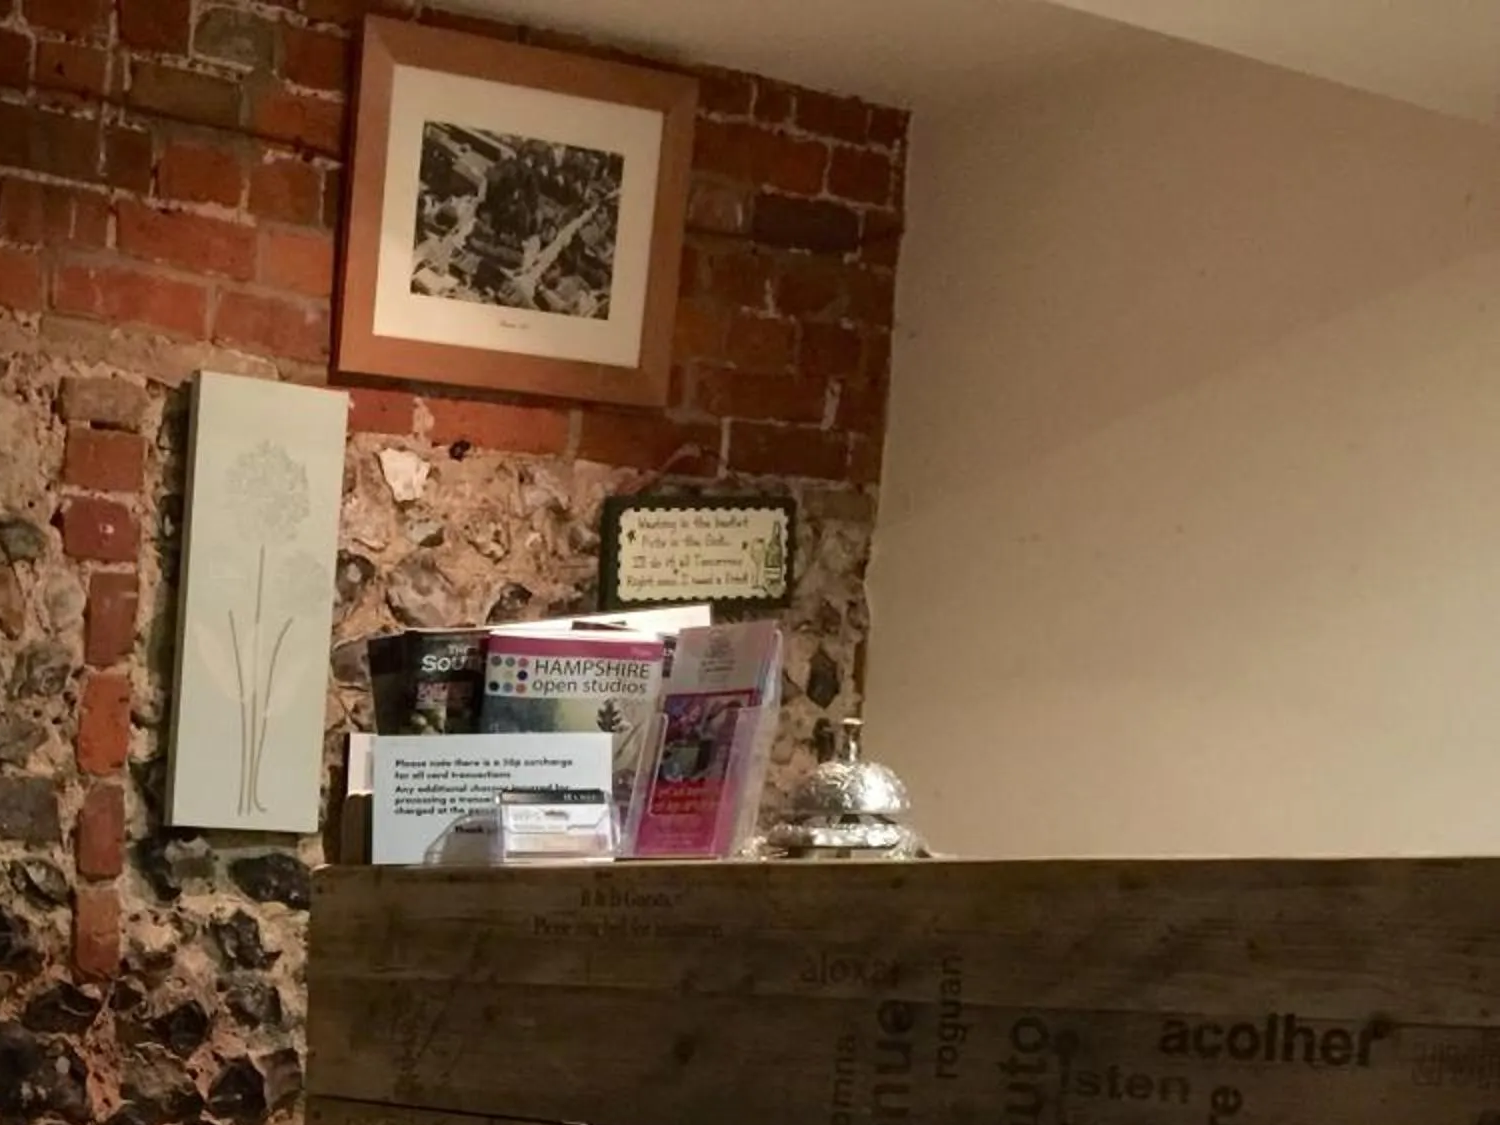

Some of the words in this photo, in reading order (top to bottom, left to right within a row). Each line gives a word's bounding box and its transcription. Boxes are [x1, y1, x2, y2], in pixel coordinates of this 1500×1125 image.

[534, 659, 650, 680] HAMPSHIRE
[532, 679, 577, 694] open
[582, 678, 647, 694] studios
[395, 758, 426, 768] Please
[429, 759, 452, 768] note
[454, 757, 480, 768] there
[524, 756, 573, 769] surcharge
[427, 769, 449, 779] card
[451, 770, 511, 780] transactions
[395, 784, 415, 794] Any
[418, 783, 468, 793] additional
[394, 806, 435, 817] charged
[1157, 1012, 1385, 1067] acolher
